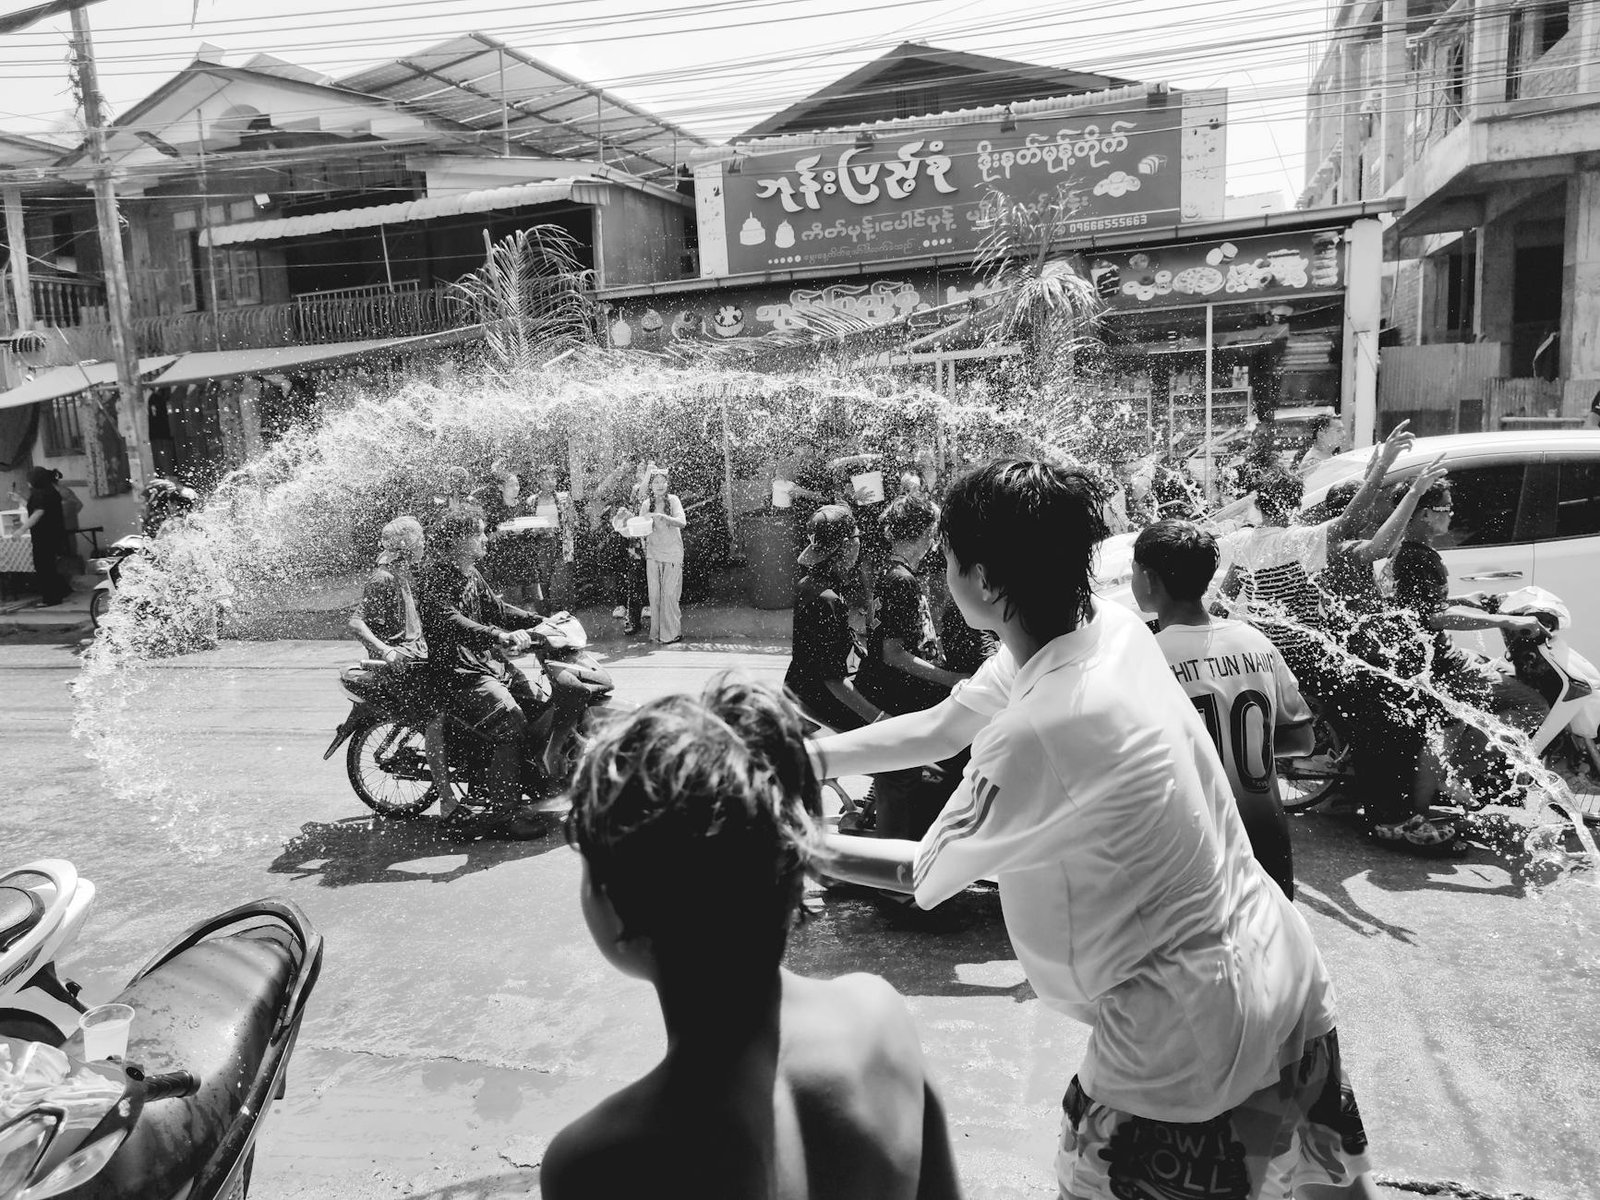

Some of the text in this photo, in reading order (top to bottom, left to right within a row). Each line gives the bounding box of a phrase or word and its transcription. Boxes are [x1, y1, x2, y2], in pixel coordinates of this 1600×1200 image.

[1169, 652, 1274, 684] HIT TUN NAIN
